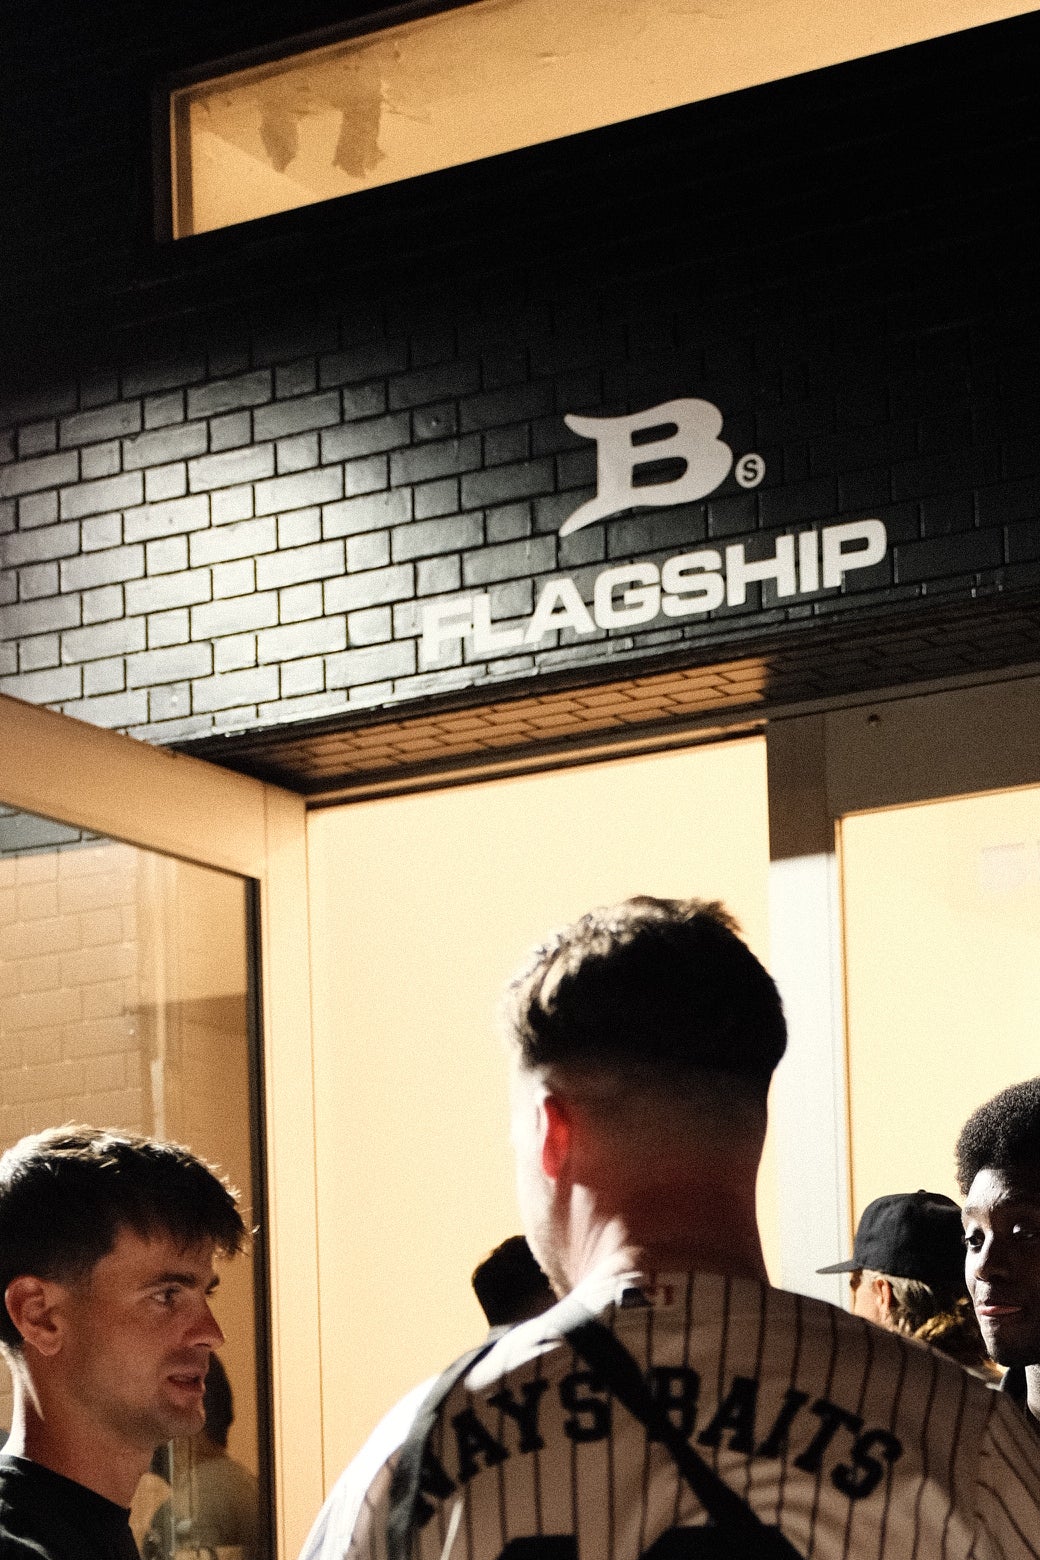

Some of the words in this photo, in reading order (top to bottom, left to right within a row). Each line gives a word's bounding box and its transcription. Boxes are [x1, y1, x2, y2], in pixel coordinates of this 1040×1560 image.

[559, 398, 733, 537] B
[420, 519, 887, 664] FLAGSHIP
[648, 1366, 902, 1498] BAITS
